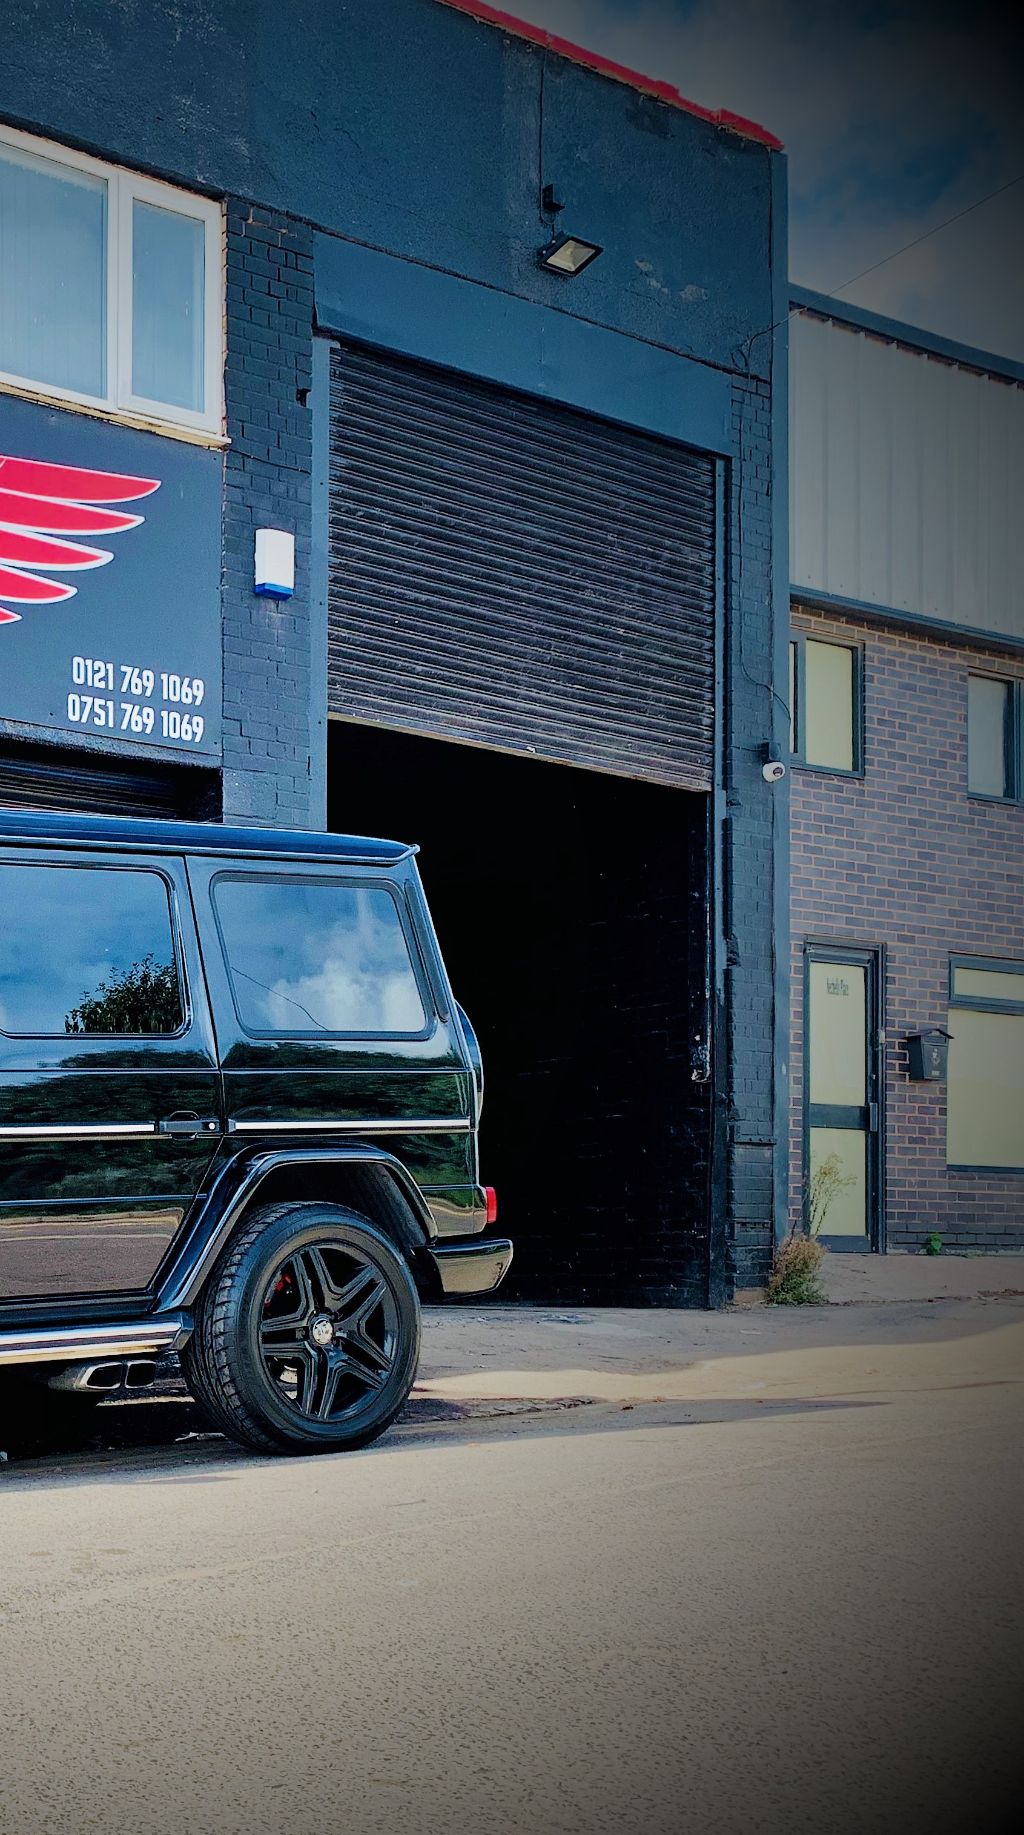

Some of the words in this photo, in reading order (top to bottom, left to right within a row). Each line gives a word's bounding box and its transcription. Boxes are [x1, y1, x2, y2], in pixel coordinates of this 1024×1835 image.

[72, 656, 114, 690] 0121
[120, 665, 155, 697] 769
[160, 672, 204, 706] 1069
[67, 693, 114, 728] 0751
[120, 703, 155, 734] 769
[160, 710, 204, 743] 1069
